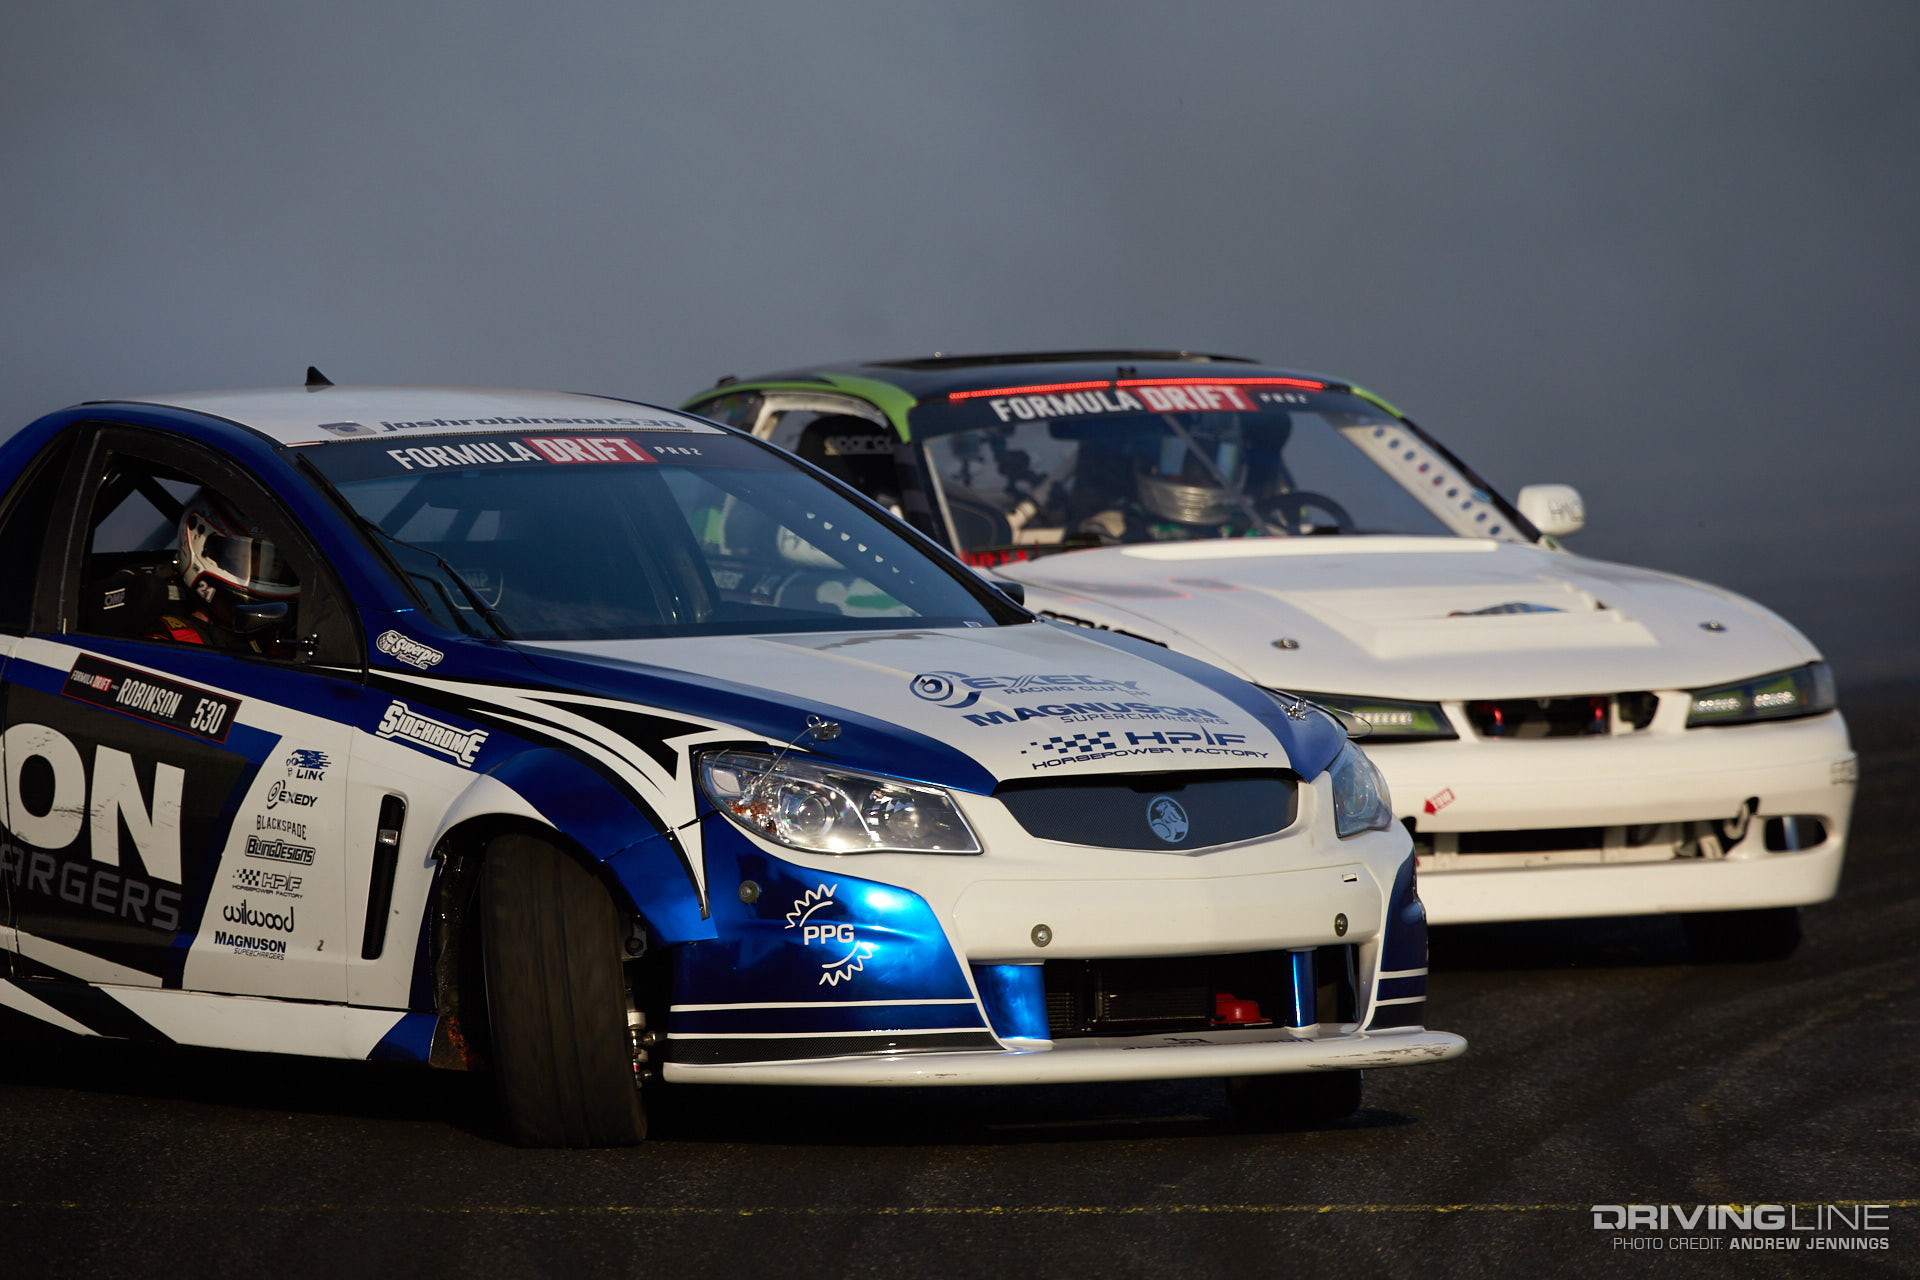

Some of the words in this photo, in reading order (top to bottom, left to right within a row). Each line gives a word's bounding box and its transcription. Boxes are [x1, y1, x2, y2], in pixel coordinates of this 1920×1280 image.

[989, 389, 1143, 423] FORMULA
[1139, 387, 1247, 411] DRIFT
[386, 441, 543, 470] FORMULA
[530, 438, 645, 462] DRIFT
[653, 446, 703, 456] PRO2
[196, 579, 216, 604] 21
[959, 674, 1141, 690] EXEDY
[1003, 685, 1074, 695] RACING
[70, 669, 94, 685] FORMULA
[91, 675, 112, 691] DRIFT
[116, 678, 183, 718] ROBINSON
[190, 698, 227, 734] 530
[963, 702, 1219, 727] MAGNUSON
[1061, 712, 1230, 725] SUPERCHARGERS
[378, 704, 487, 763] SIDCHROME
[1031, 748, 1174, 770] HORSEPOWER
[1182, 747, 1269, 759] FACTORY
[0, 723, 185, 885] ON
[279, 791, 318, 807] EXEDY
[256, 814, 307, 840] BLACKSPADE
[0, 844, 182, 931] ARGERS
[232, 885, 273, 895] HORSEPOWER
[276, 891, 303, 899] FACTORY
[223, 899, 294, 933] wilwood
[214, 931, 286, 953] MAGNUSON
[804, 924, 854, 945] PPG
[233, 948, 285, 961] SUPERCHARGERS
